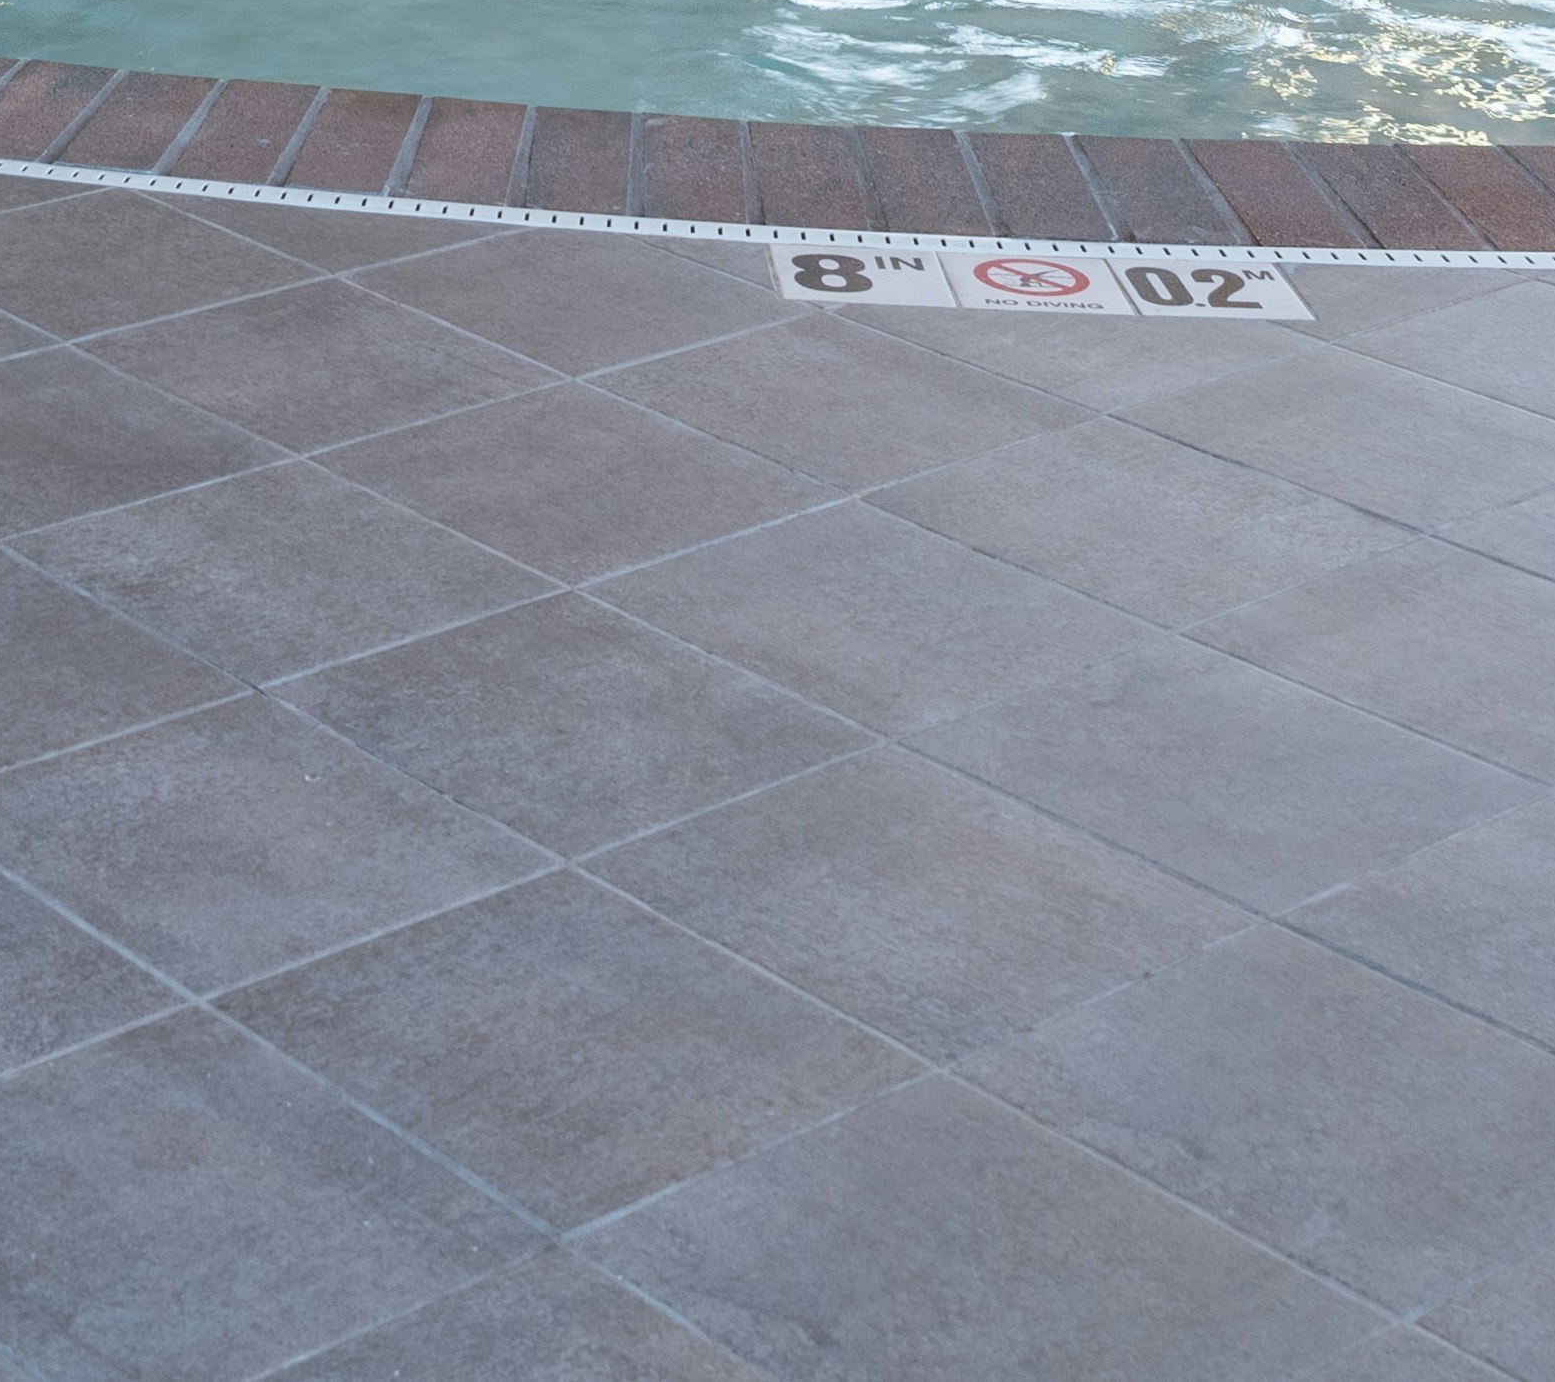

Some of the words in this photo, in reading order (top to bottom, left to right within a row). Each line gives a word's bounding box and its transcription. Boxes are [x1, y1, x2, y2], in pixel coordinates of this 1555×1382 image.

[791, 254, 873, 293] 8
[875, 256, 925, 271] IN
[1124, 266, 1264, 309] 0.2
[985, 298, 1019, 307] NO
[1026, 300, 1104, 310] DIVING
